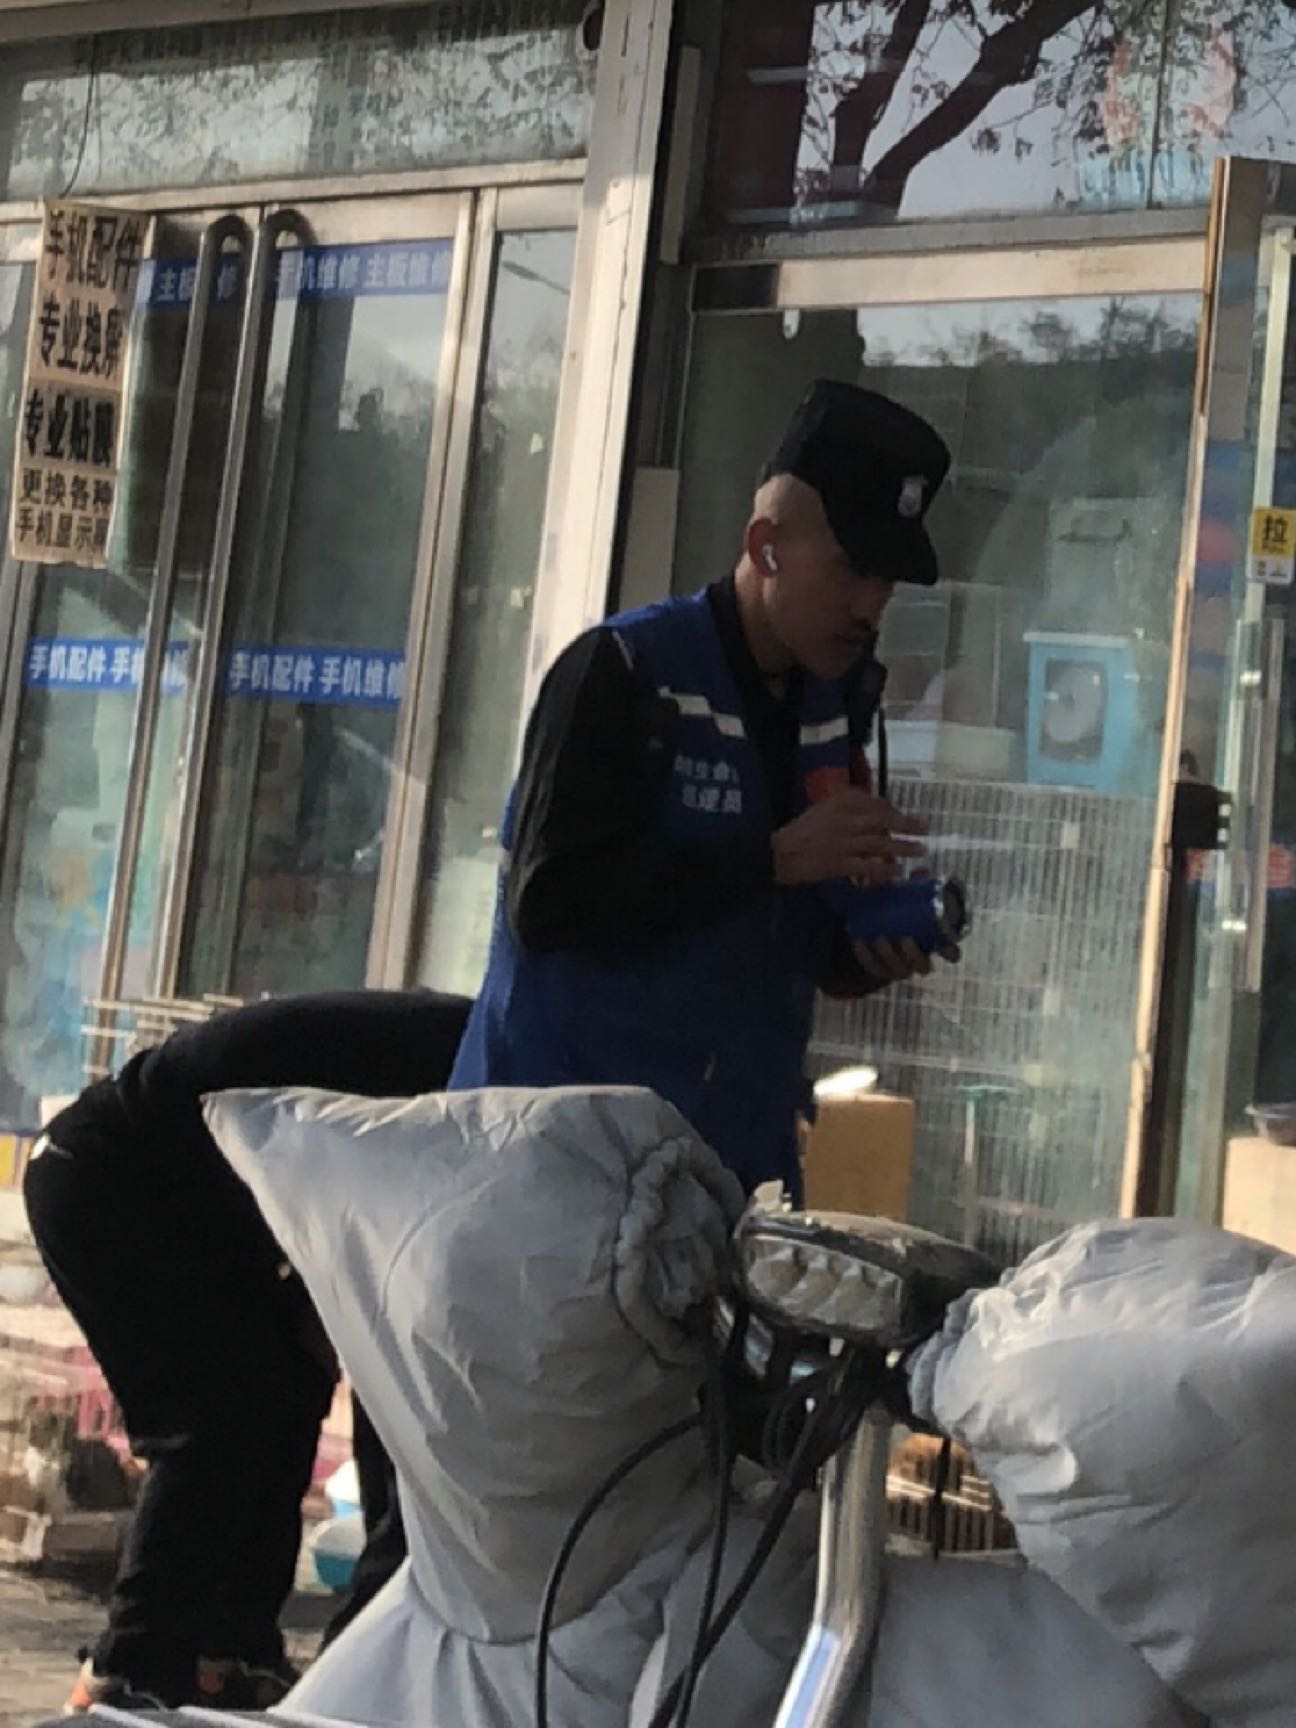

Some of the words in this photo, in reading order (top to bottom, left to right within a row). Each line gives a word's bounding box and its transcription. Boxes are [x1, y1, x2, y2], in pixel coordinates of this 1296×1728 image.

[1262, 514, 1287, 543] 拉
[29, 642, 107, 684] 手机配件
[229, 650, 315, 694] 手机配件
